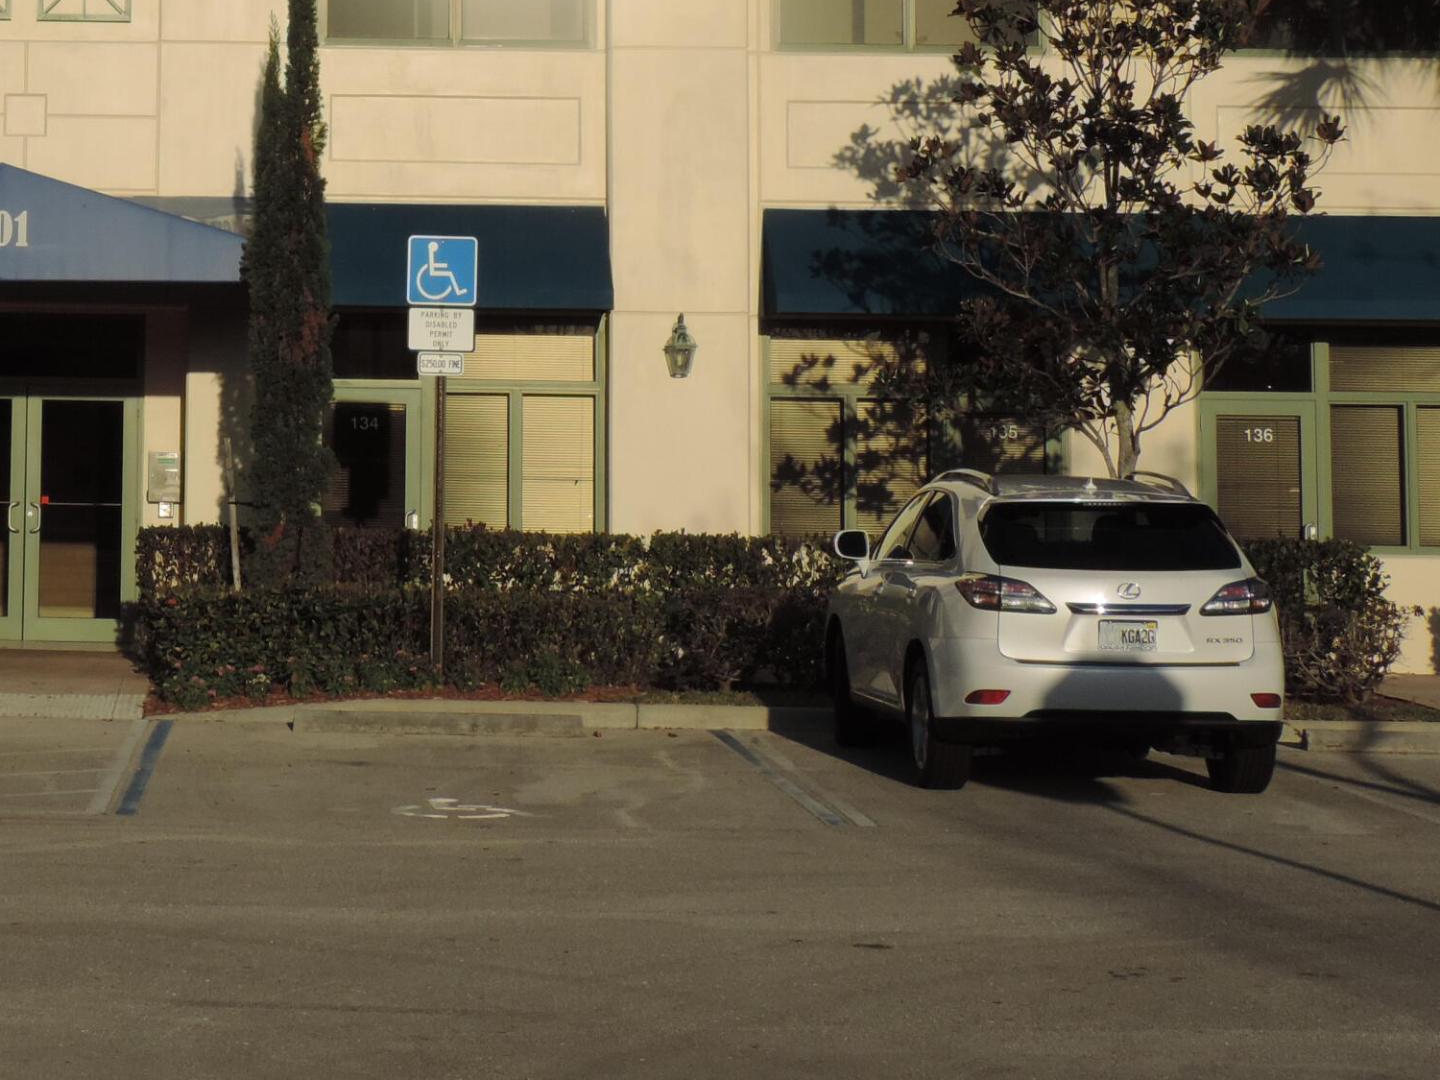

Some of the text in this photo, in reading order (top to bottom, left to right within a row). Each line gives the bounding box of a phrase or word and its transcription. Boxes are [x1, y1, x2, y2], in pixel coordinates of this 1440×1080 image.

[420, 311, 463, 320] PARKING BY
[425, 320, 458, 329] DISABLED
[429, 330, 453, 338] PERMIT
[432, 340, 449, 348] ONLY
[448, 359, 460, 369] FINE
[351, 416, 379, 431] 134
[990, 424, 1018, 439] 135
[1244, 428, 1273, 443] 136
